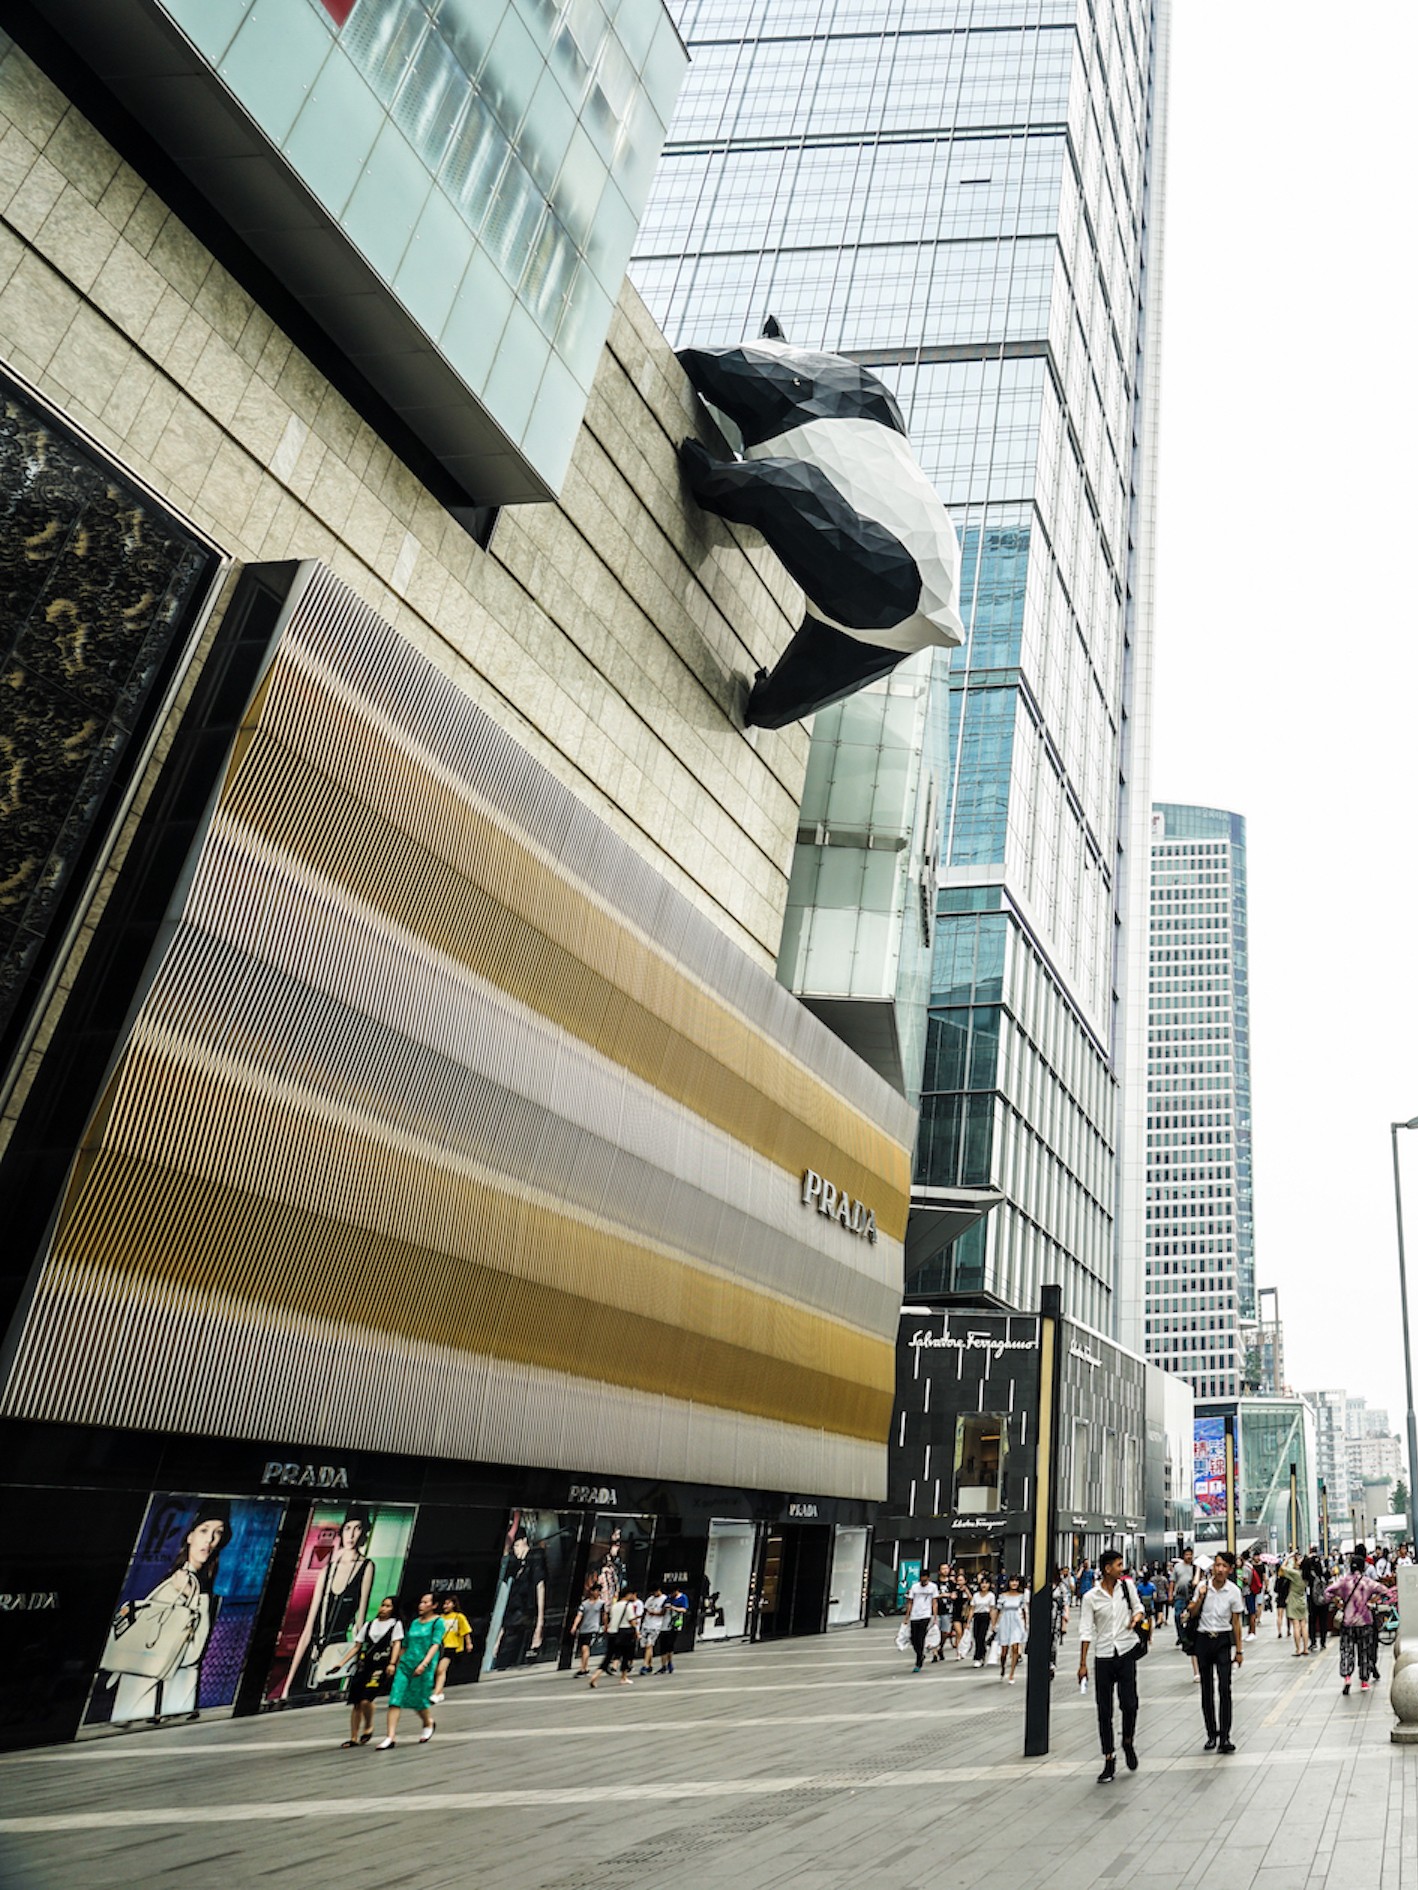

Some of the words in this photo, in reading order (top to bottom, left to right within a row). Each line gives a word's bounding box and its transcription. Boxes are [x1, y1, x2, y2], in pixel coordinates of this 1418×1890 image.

[801, 1168, 879, 1245] PRADA
[908, 1330, 966, 1348] Salvatore
[966, 1330, 1036, 1359] Ferragamo
[261, 1462, 349, 1489] PRADA
[568, 1485, 618, 1505] PRADA
[789, 1503, 818, 1518] PRADA
[430, 1578, 472, 1592] PRADA
